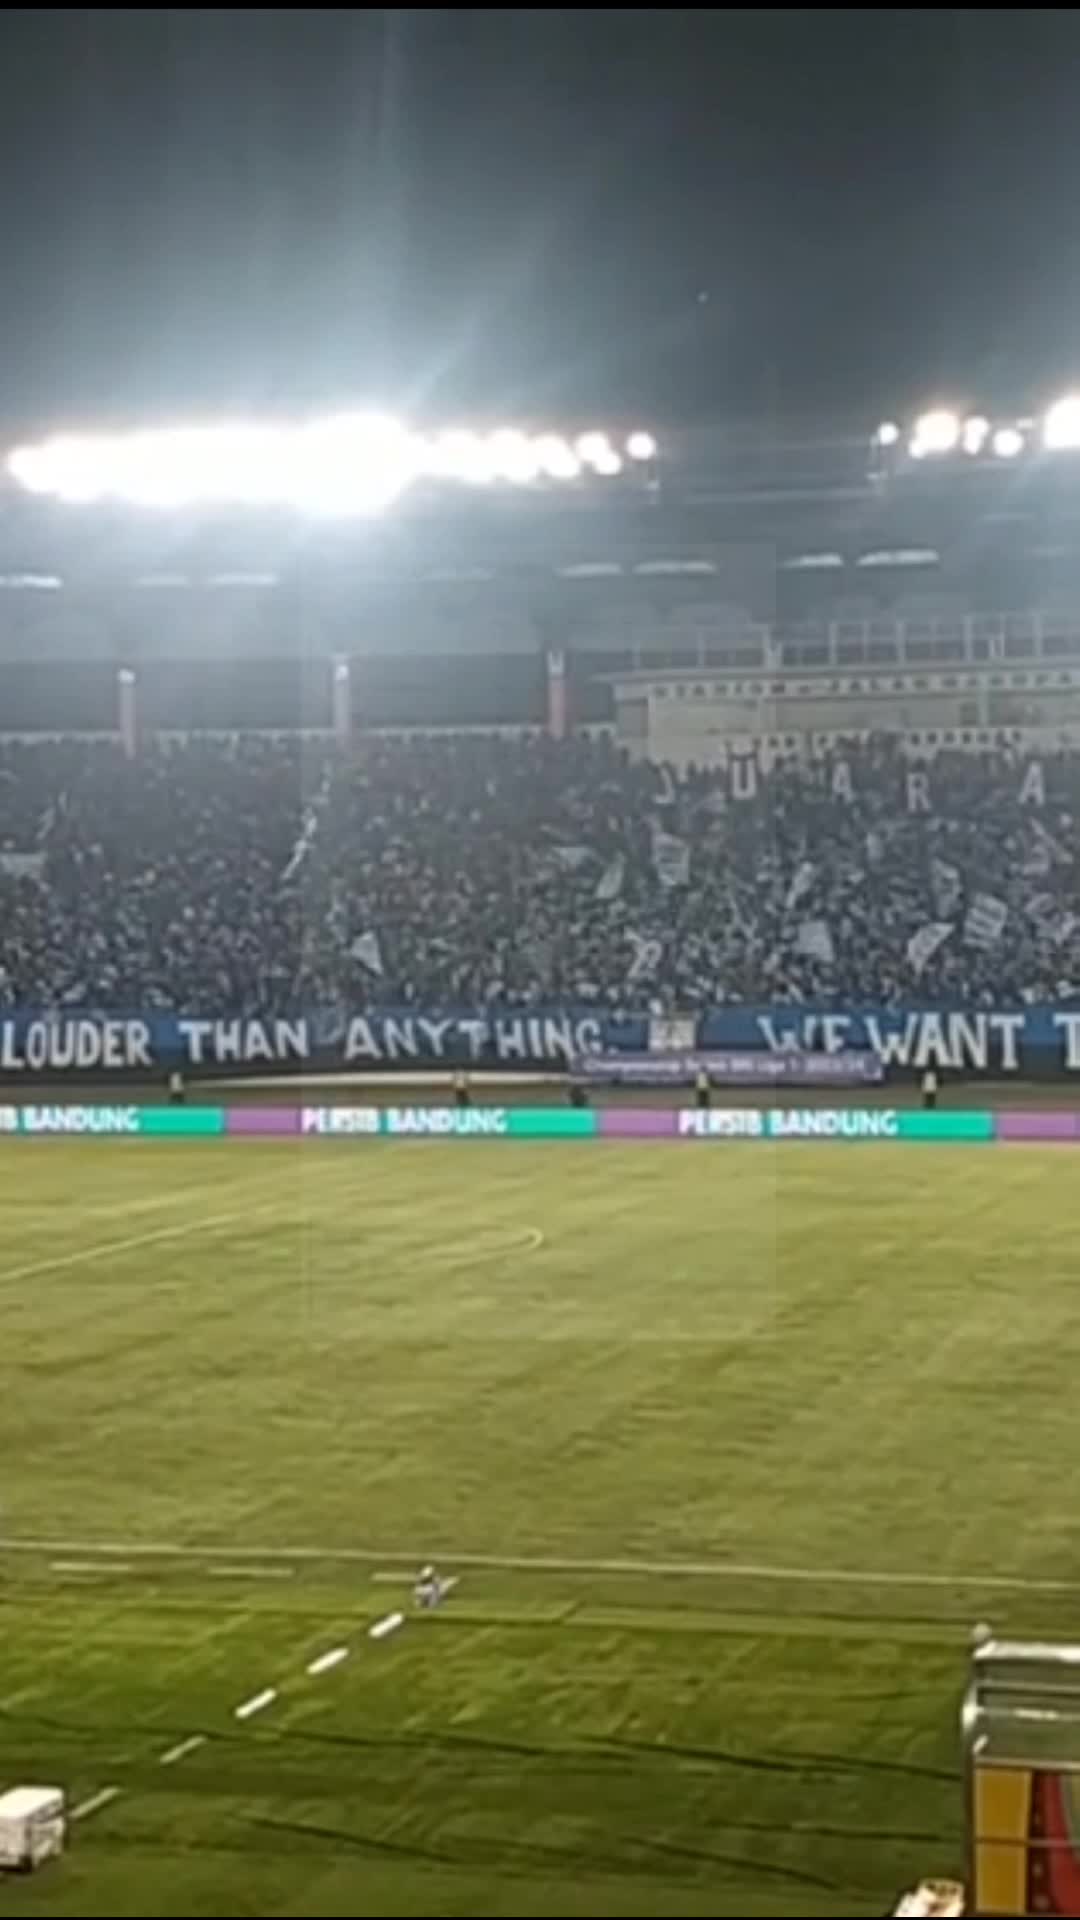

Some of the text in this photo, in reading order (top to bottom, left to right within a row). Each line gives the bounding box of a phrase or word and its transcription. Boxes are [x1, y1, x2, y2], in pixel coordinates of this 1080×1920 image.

[1, 1020, 154, 1069] LOUDER
[178, 1018, 310, 1064] THAN
[864, 1011, 1026, 1069] WANT
[22, 1106, 140, 1132] BANDUNG
[301, 1107, 507, 1133] PERSIB BANDUNG
[679, 1109, 898, 1137] PERSIB BANDUNG
